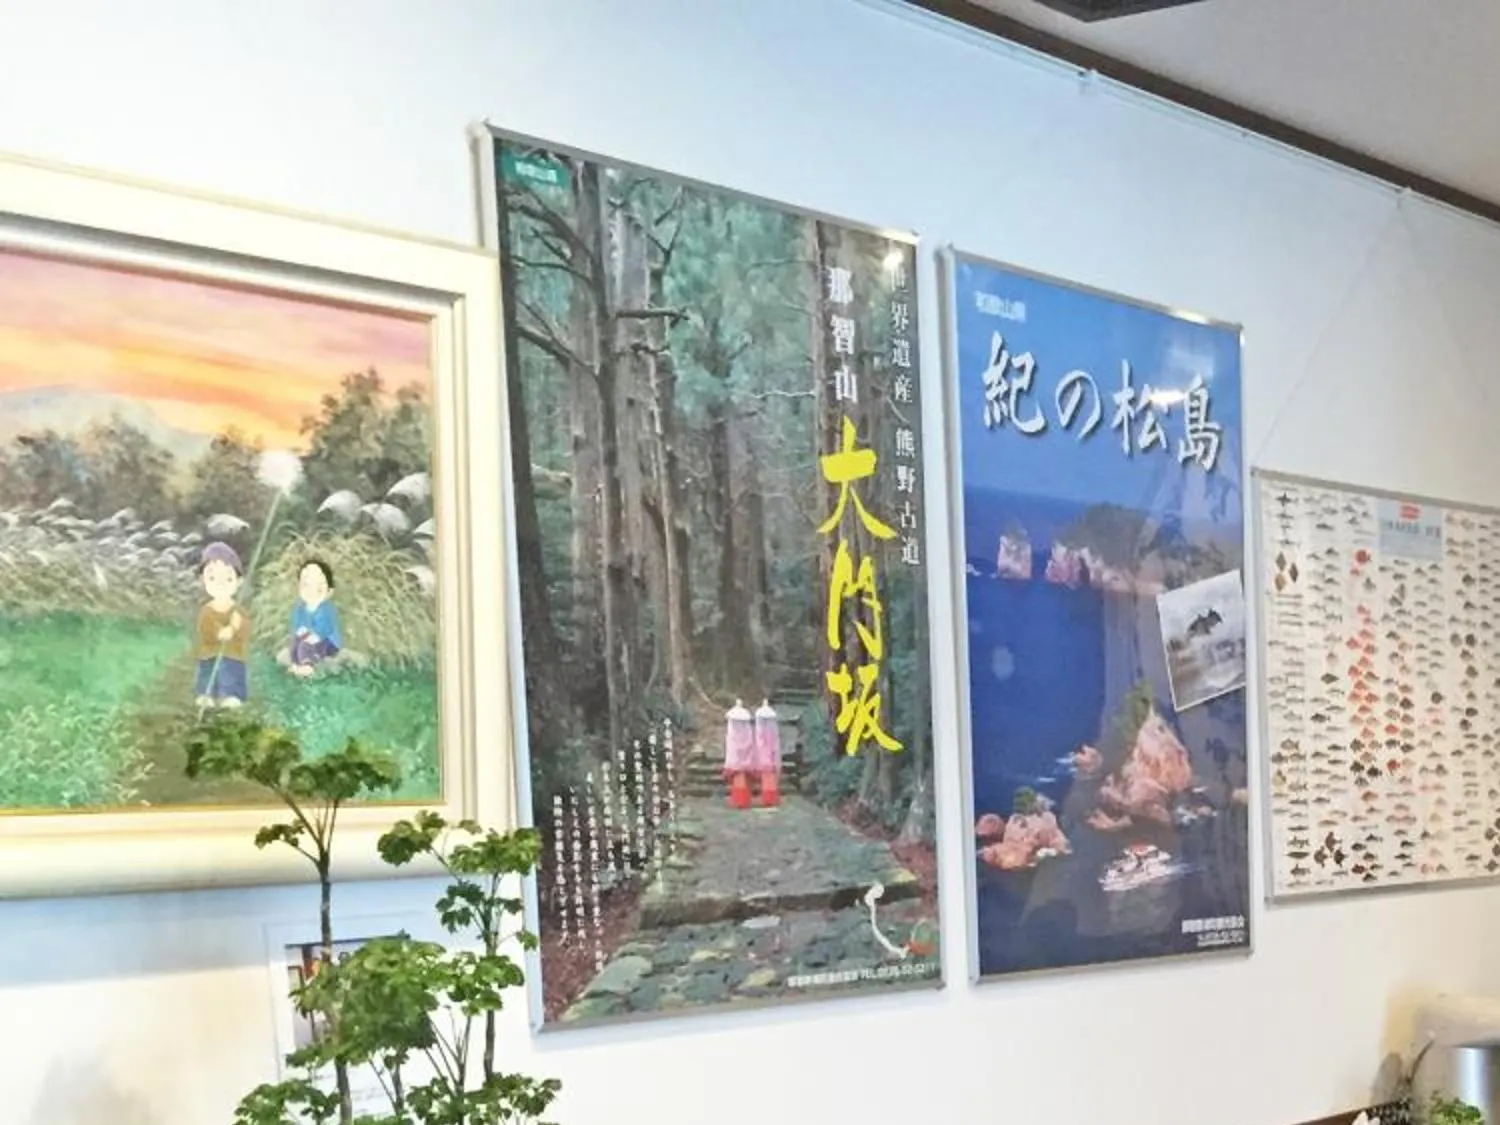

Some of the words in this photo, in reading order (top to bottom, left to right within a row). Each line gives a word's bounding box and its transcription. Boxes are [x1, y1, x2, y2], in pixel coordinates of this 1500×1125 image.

[827, 266, 858, 403] 那智山
[982, 330, 1223, 471] 紀の松島
[894, 427, 921, 566] 熊野古道
[816, 415, 903, 757] 大門坂
